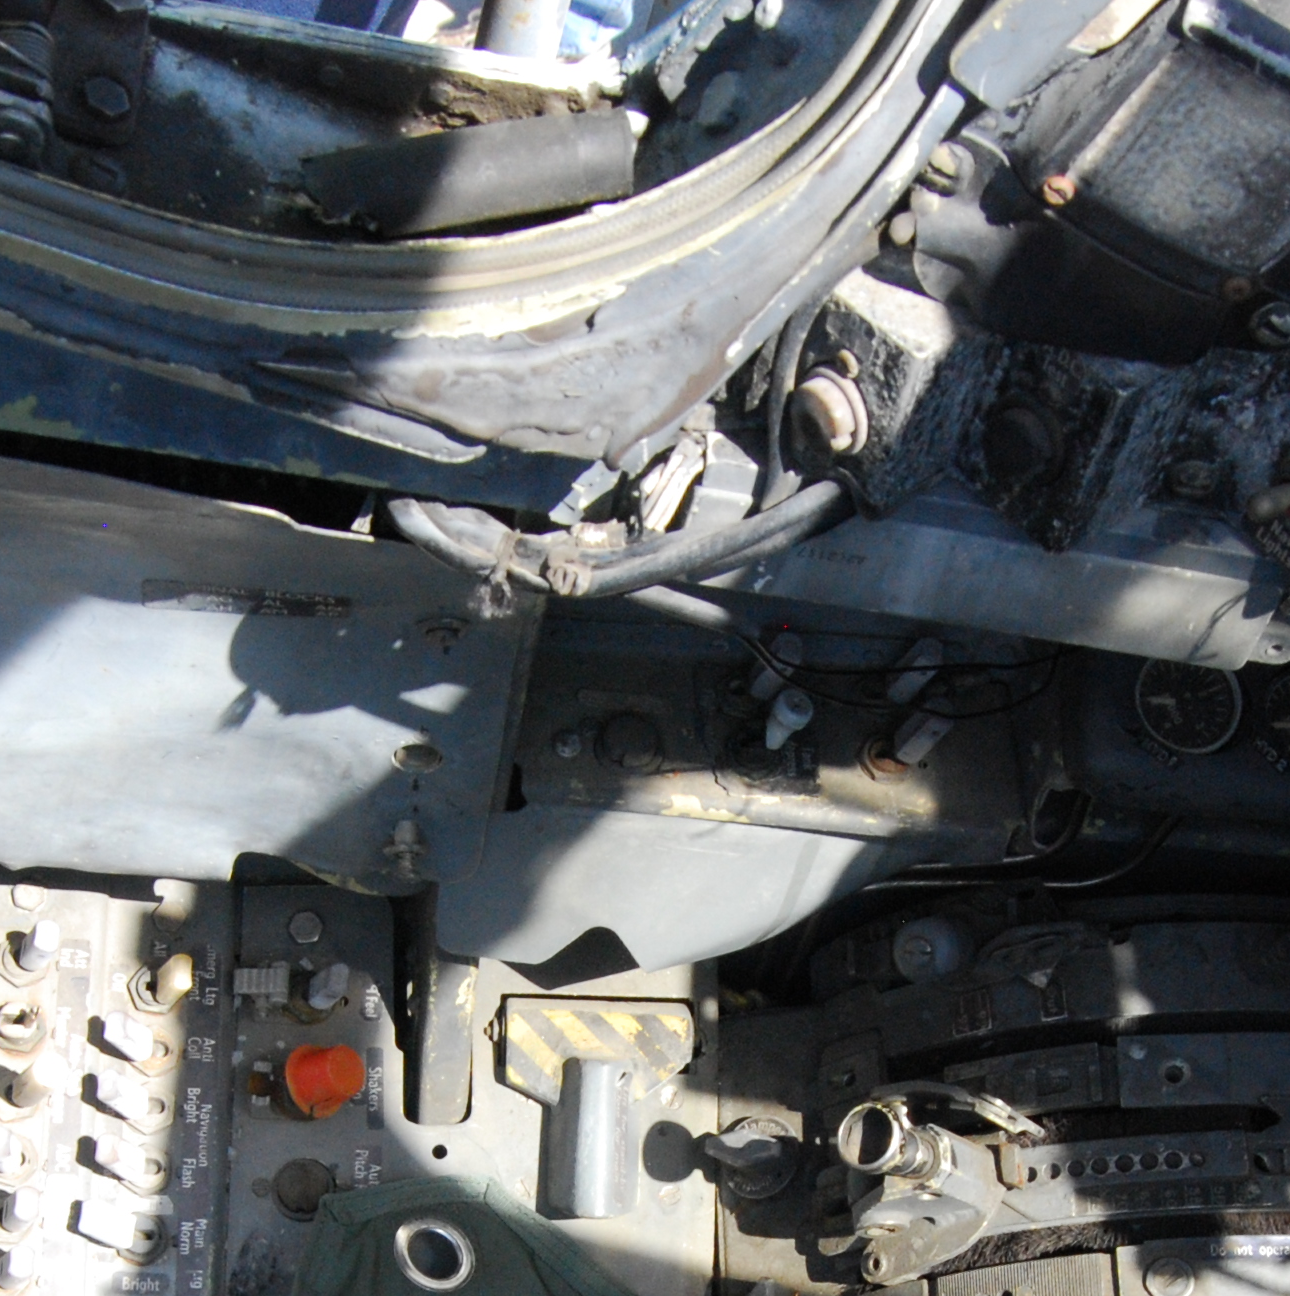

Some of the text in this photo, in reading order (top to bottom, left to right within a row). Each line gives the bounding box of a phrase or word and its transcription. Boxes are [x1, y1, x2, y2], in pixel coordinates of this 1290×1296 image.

[202, 944, 217, 979] merg
[202, 1037, 216, 1062] Anti
[368, 1066, 383, 1112] Shakers
[184, 1088, 200, 1123] Bright
[181, 1158, 196, 1188] Flash
[354, 1149, 369, 1179] Pitch
[179, 1222, 194, 1255] Norm
[194, 1218, 208, 1248] Main
[1233, 1243, 1253, 1256] not
[122, 1275, 161, 1293] Bright
